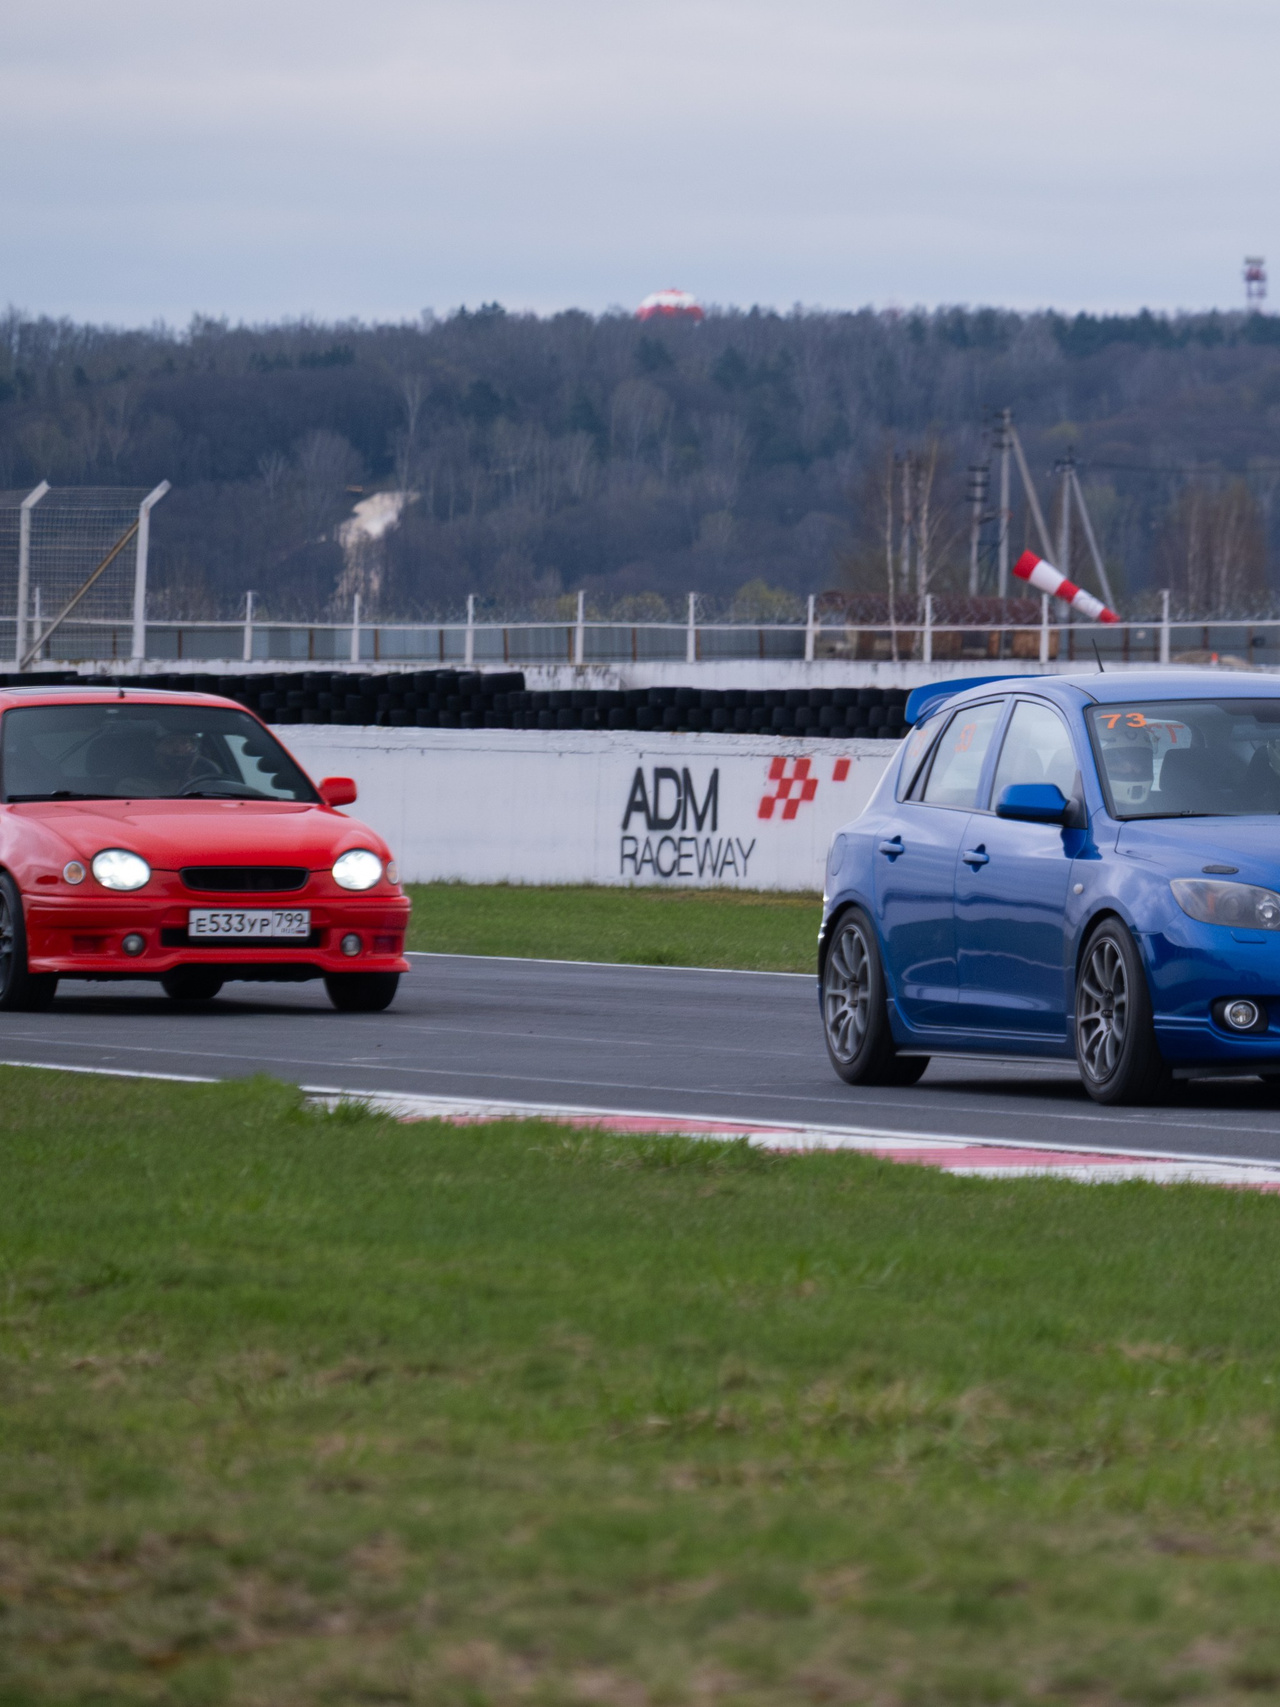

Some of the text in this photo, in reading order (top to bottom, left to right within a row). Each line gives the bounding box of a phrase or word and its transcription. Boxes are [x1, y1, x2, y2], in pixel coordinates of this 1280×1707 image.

[1099, 712, 1147, 729] 73
[622, 766, 719, 832] ADM
[620, 835, 756, 878] RACEWAY
[274, 913, 304, 928] 799
